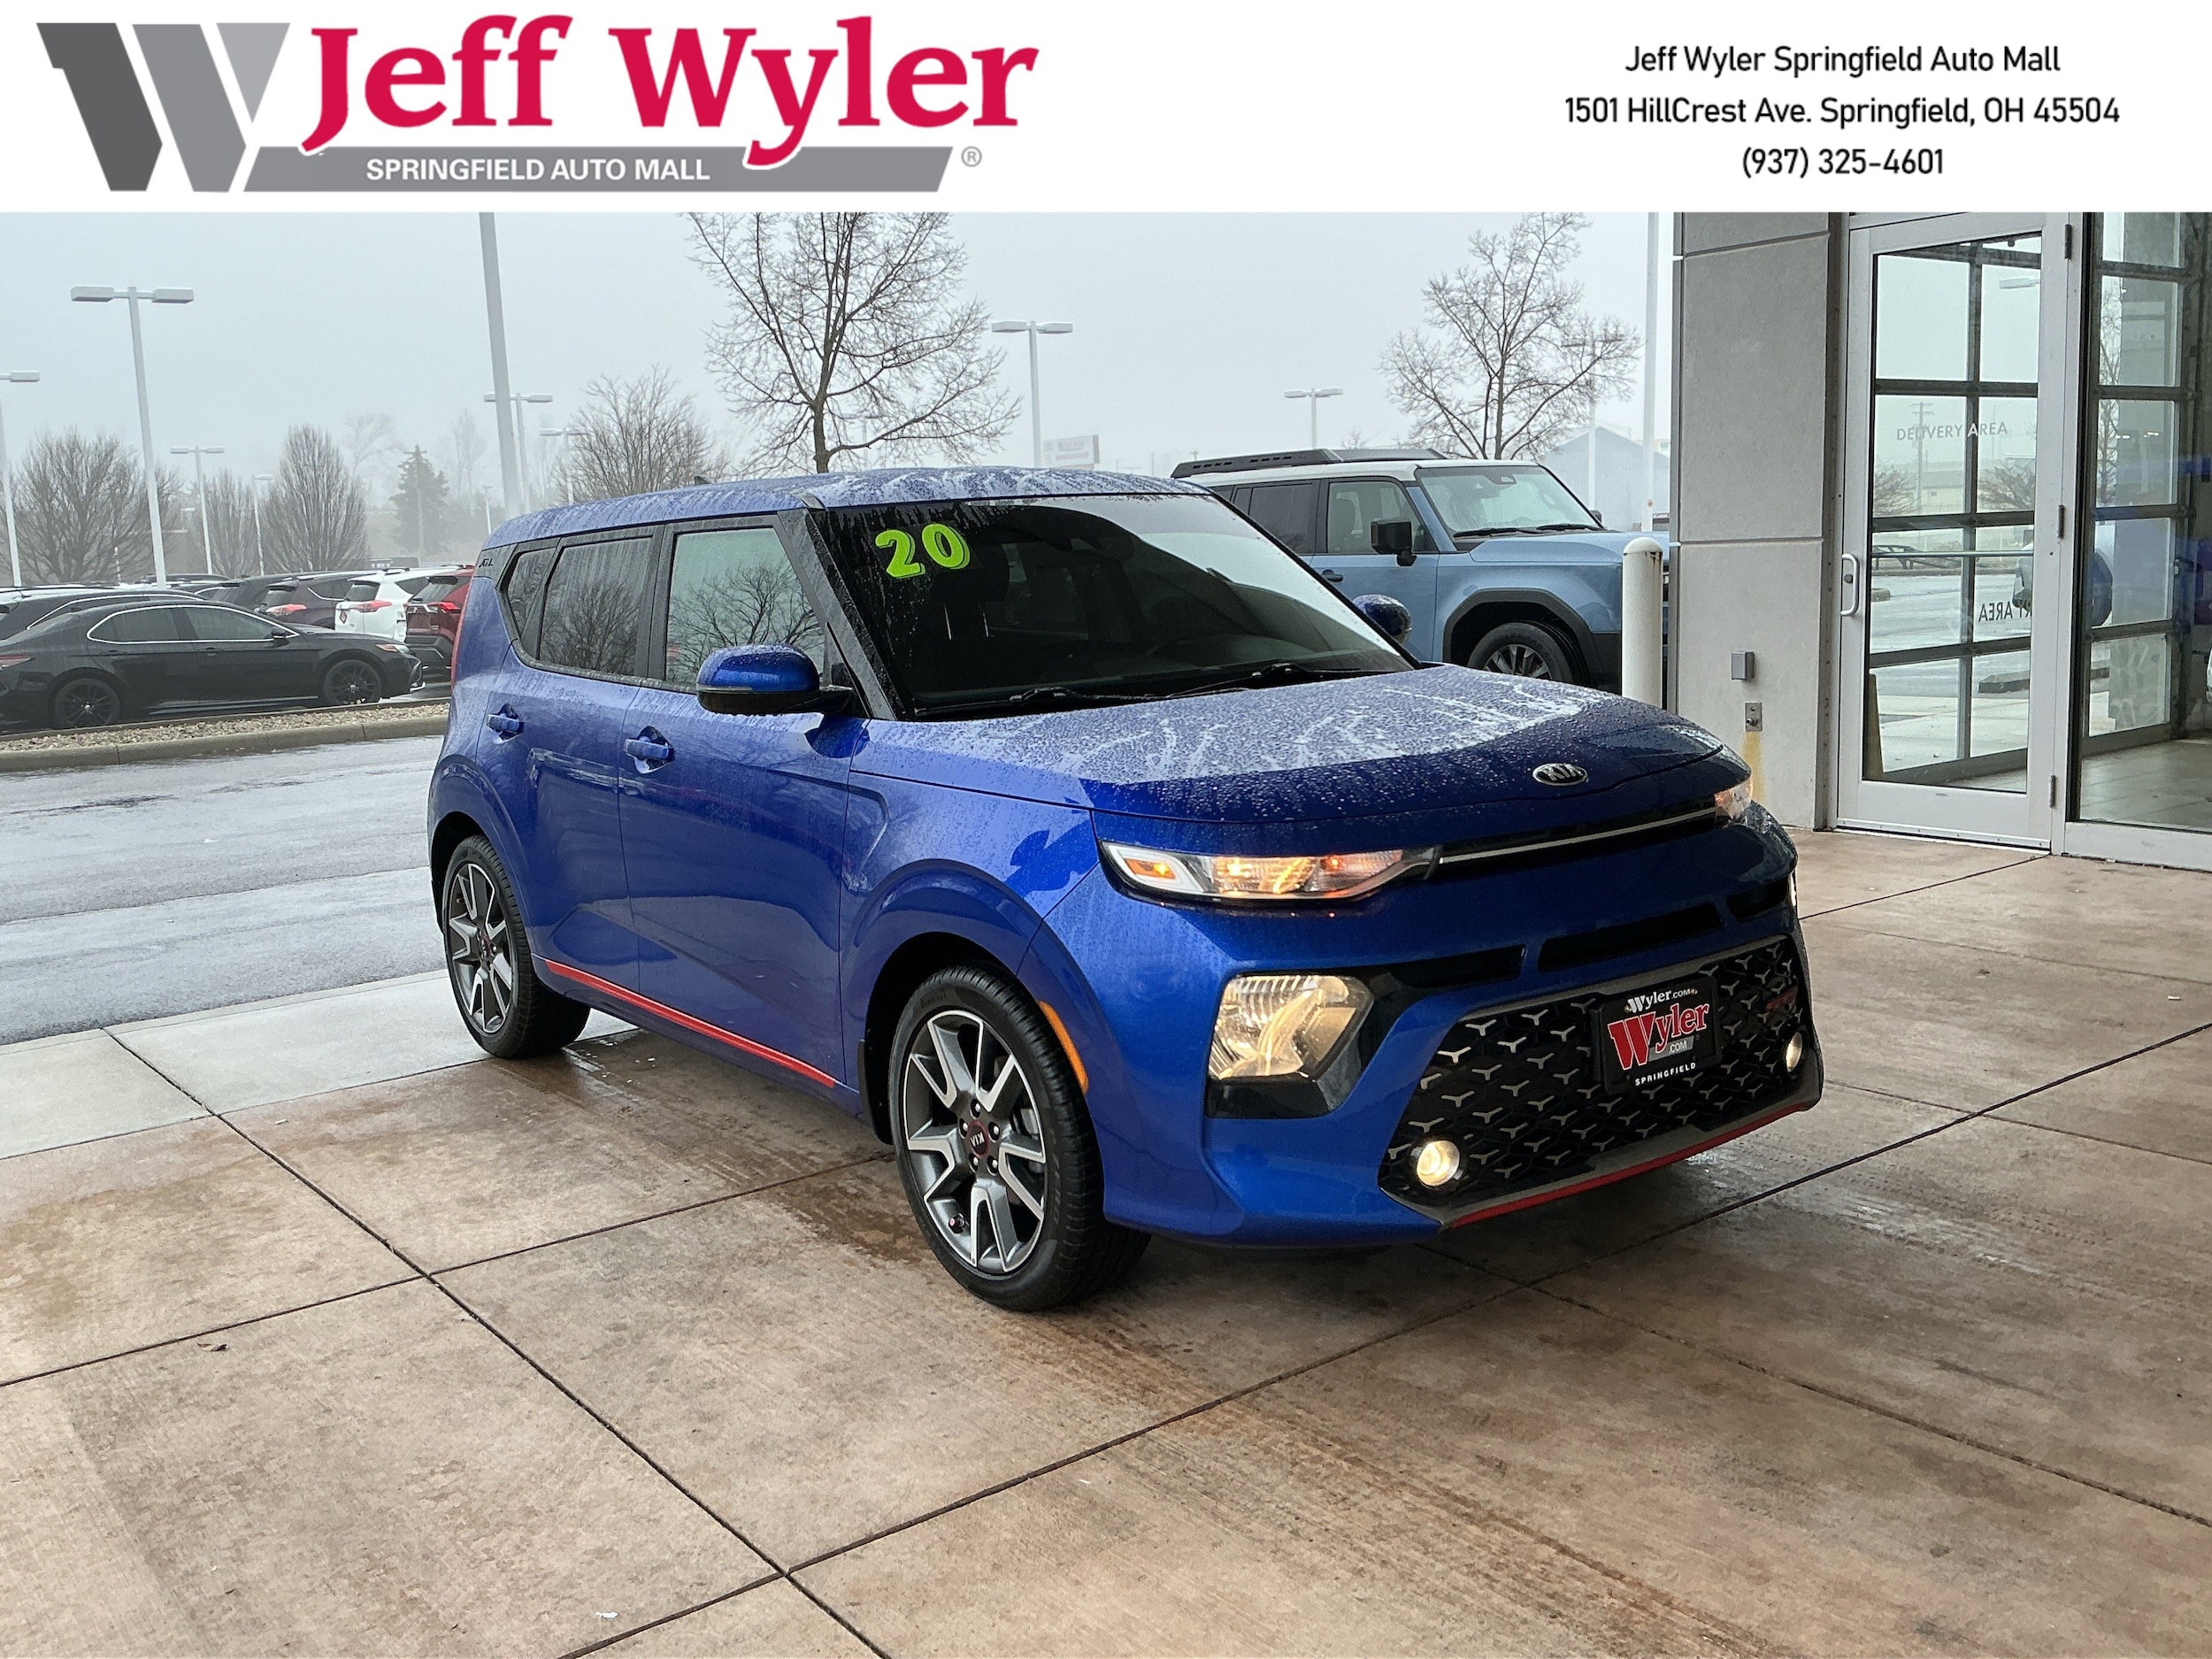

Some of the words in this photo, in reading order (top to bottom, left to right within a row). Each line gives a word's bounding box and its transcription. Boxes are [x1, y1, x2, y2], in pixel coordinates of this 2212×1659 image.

[1967, 422, 2008, 437] AREA
[875, 523, 971, 580] 20
[1607, 1002, 1709, 1071] Wyler
[1634, 1062, 1696, 1086] SPRINGFIELD
